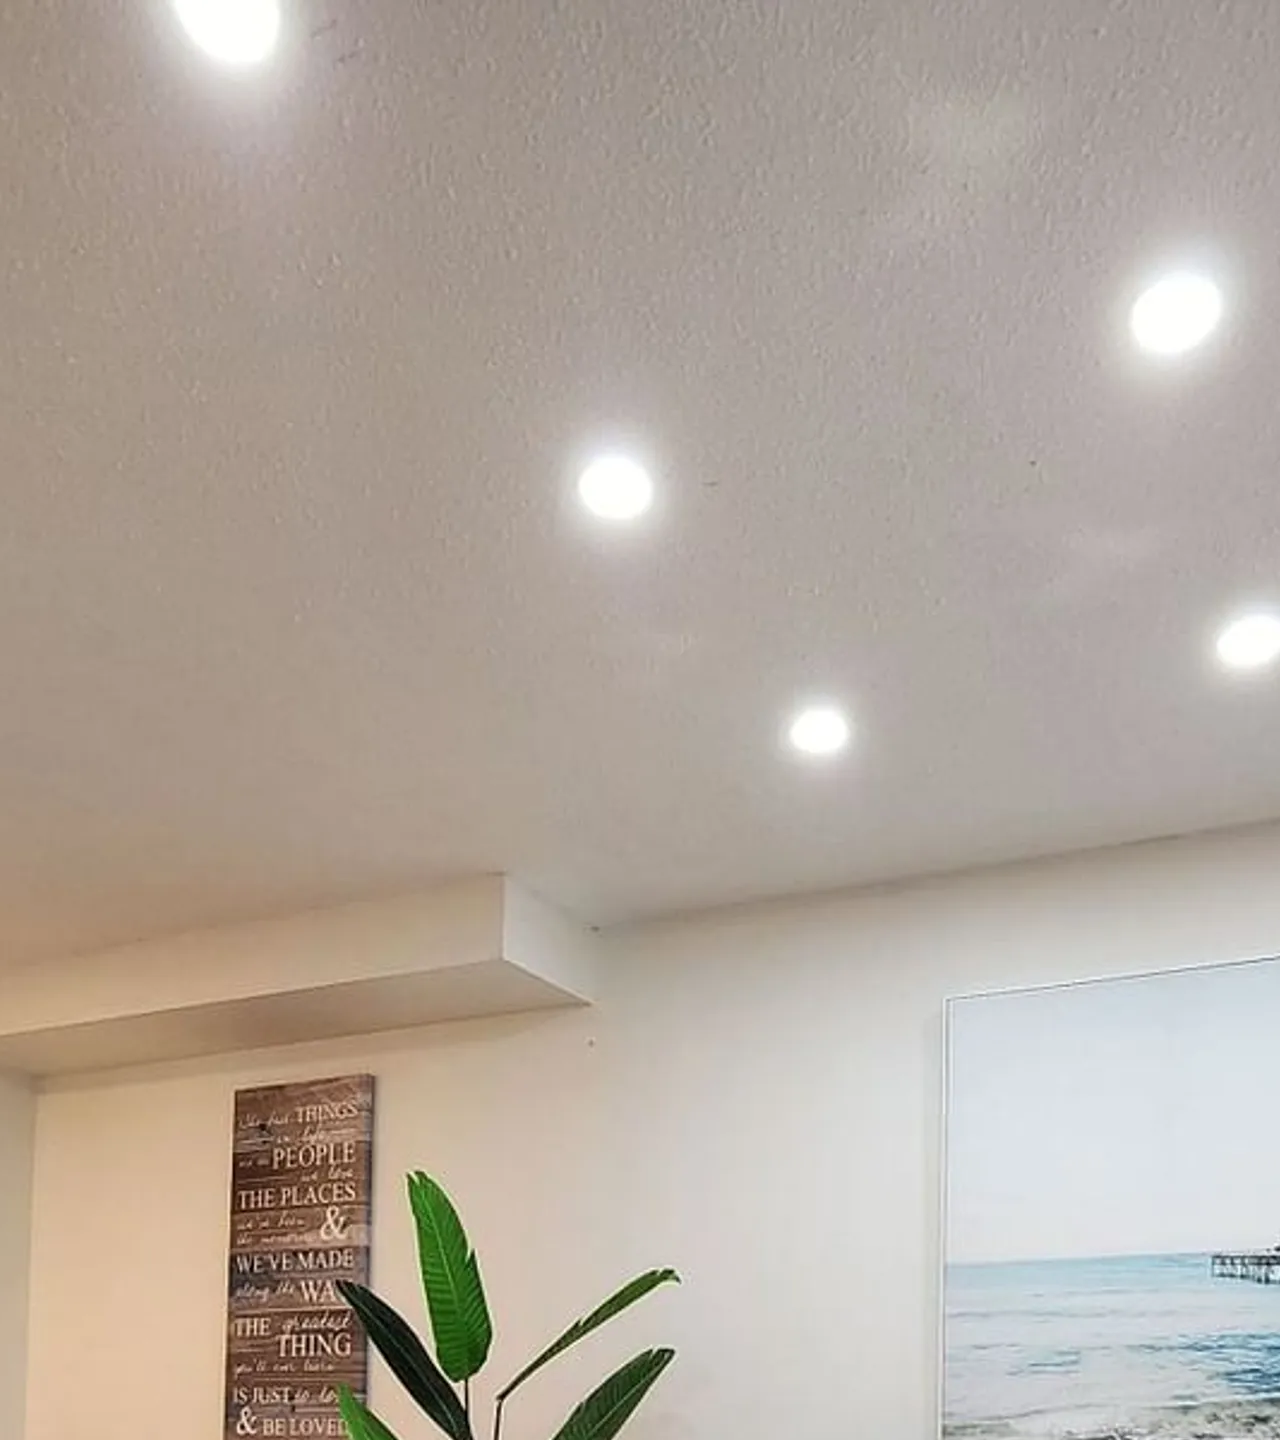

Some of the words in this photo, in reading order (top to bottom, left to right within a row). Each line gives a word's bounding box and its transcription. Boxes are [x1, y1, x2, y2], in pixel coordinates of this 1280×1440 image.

[295, 1101, 358, 1123] THINGS
[272, 1141, 356, 1170] PEOPLE
[238, 1187, 276, 1209] THE
[280, 1182, 356, 1206] PLACES
[320, 1205, 351, 1240] &
[236, 1252, 293, 1273] WE'VE
[298, 1248, 355, 1269] MADE
[300, 1280, 340, 1303] WA
[233, 1317, 271, 1337] THE
[278, 1331, 352, 1358] THING
[233, 1387, 248, 1404] IS
[252, 1386, 293, 1405] JUST
[236, 1405, 260, 1436] &
[262, 1418, 287, 1437] BE
